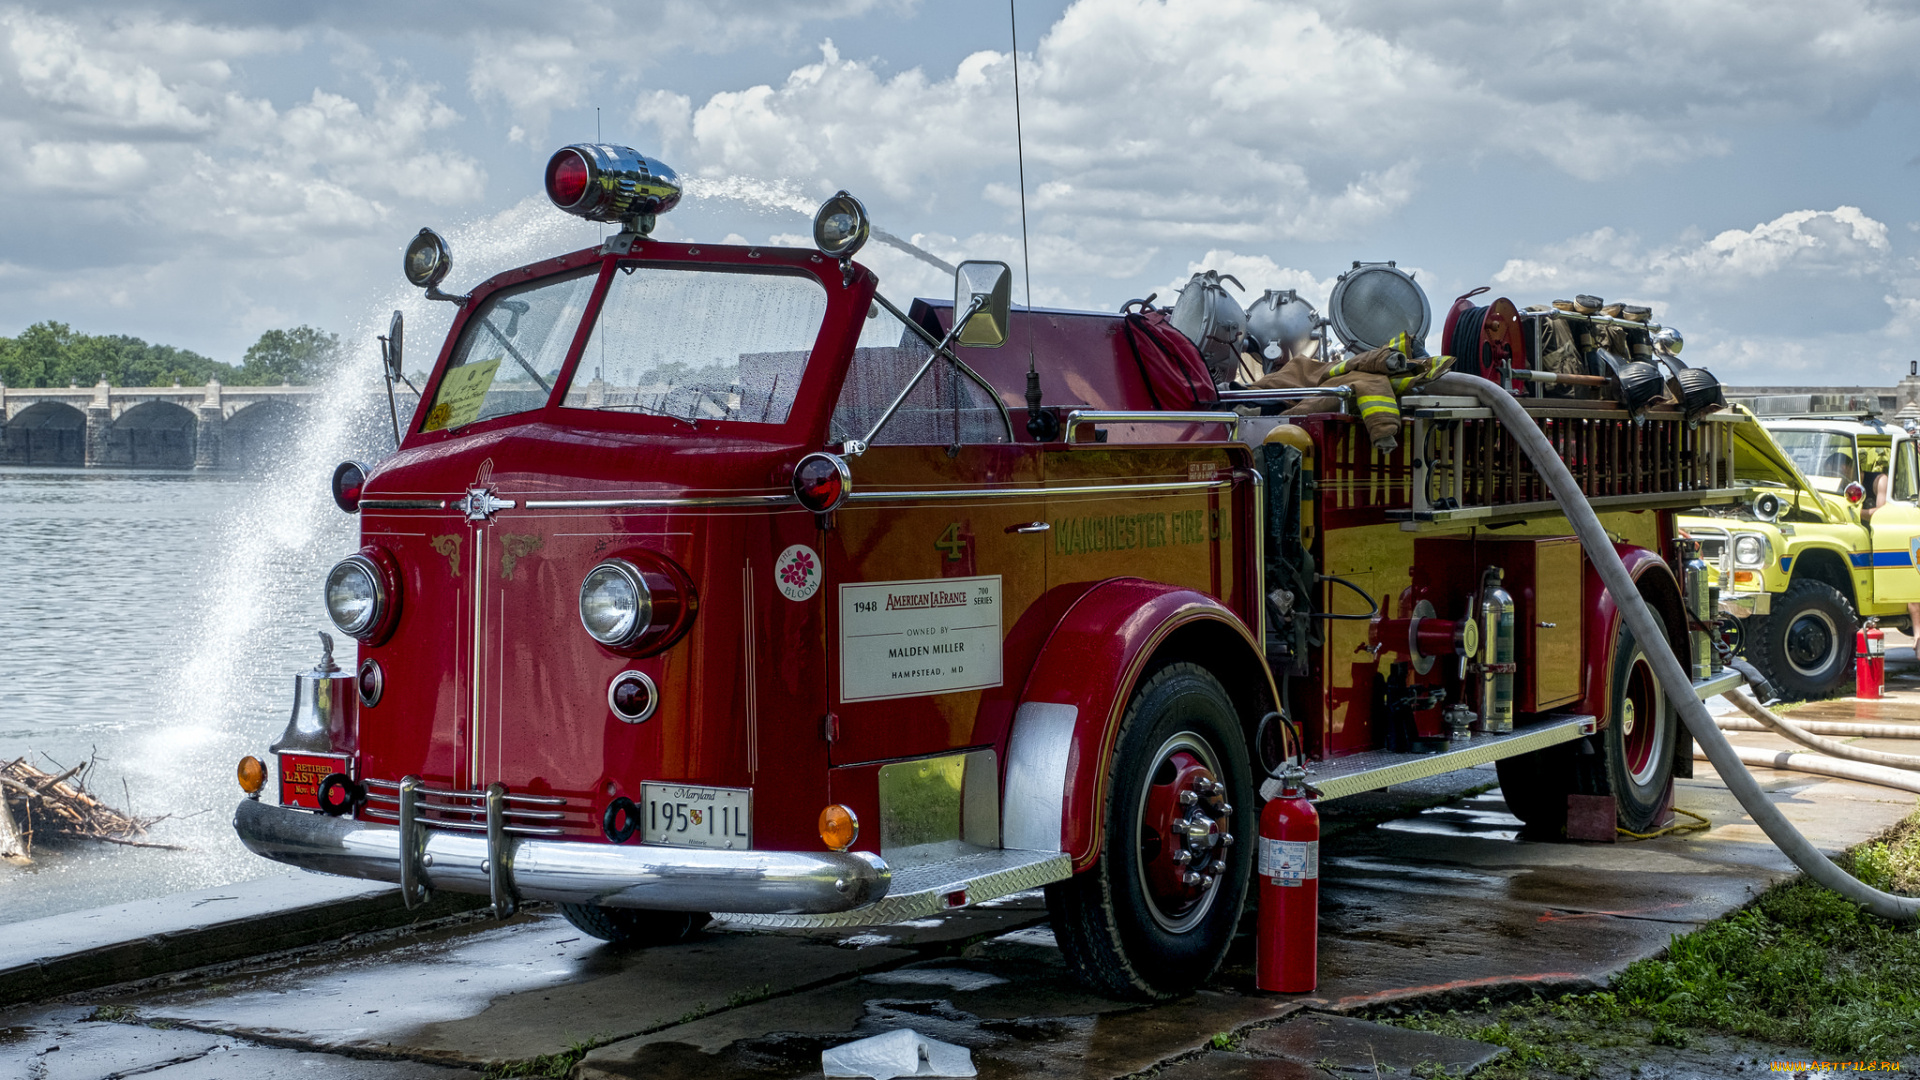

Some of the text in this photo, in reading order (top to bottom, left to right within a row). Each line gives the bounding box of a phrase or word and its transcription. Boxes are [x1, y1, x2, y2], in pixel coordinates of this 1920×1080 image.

[1054, 512, 1167, 556] MANCHESTER
[1171, 509, 1204, 545] FIRE
[934, 522, 966, 562] 4
[779, 550, 792, 564] THE
[784, 581, 818, 598] BLOOM
[978, 587, 989, 595] 700
[853, 601, 878, 613] 1948
[885, 593, 929, 611] AMERICAN
[973, 596, 993, 605] SERIES
[906, 628, 936, 637] OWNED
[888, 642, 965, 658] MALDEN MILLER
[891, 666, 964, 679] HAMPSTEAD, MD
[294, 763, 332, 774] RETIRED
[284, 771, 314, 785] LAST
[674, 788, 716, 803] Maryland
[650, 801, 746, 837] 195 11L
